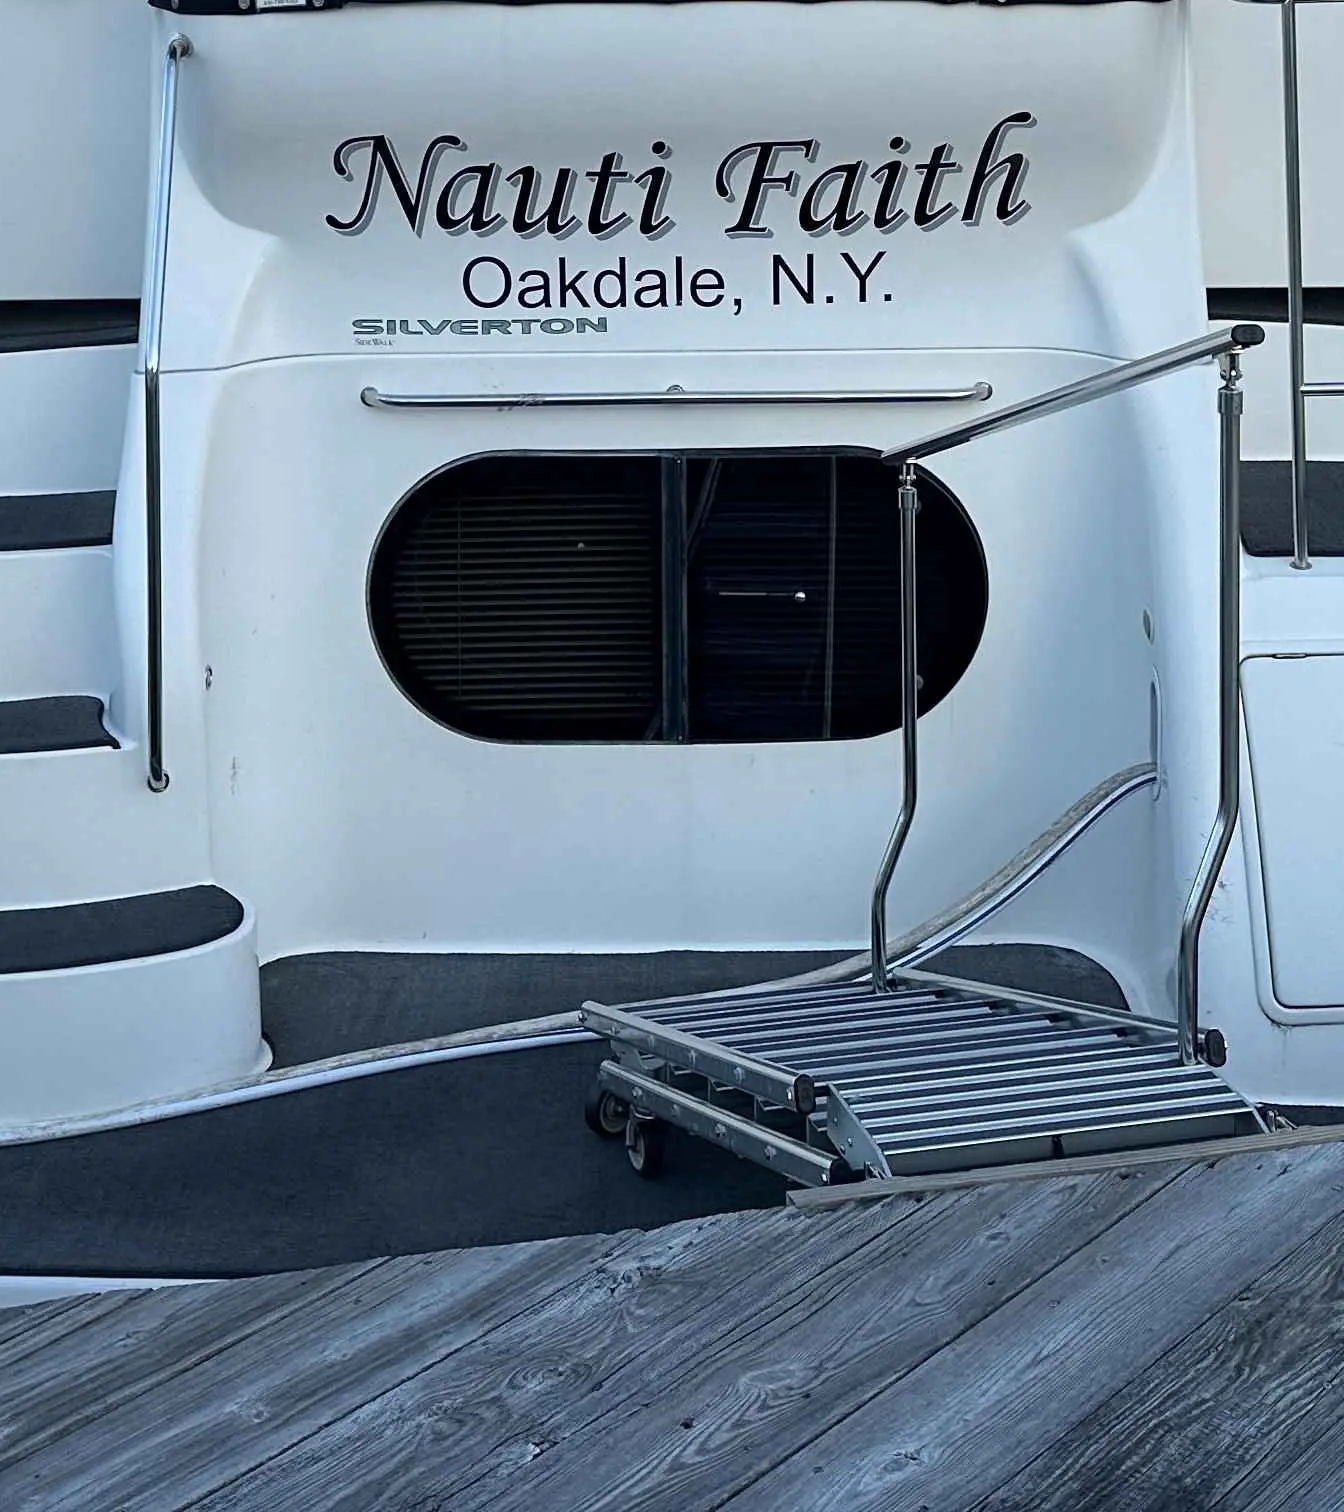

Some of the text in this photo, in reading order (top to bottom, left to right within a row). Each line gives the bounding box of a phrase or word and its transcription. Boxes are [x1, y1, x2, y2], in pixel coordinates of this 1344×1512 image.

[325, 111, 1039, 241] Nauti Faith
[462, 250, 892, 317] Oakdale, N.Y.
[351, 316, 608, 336] SILVERTON
